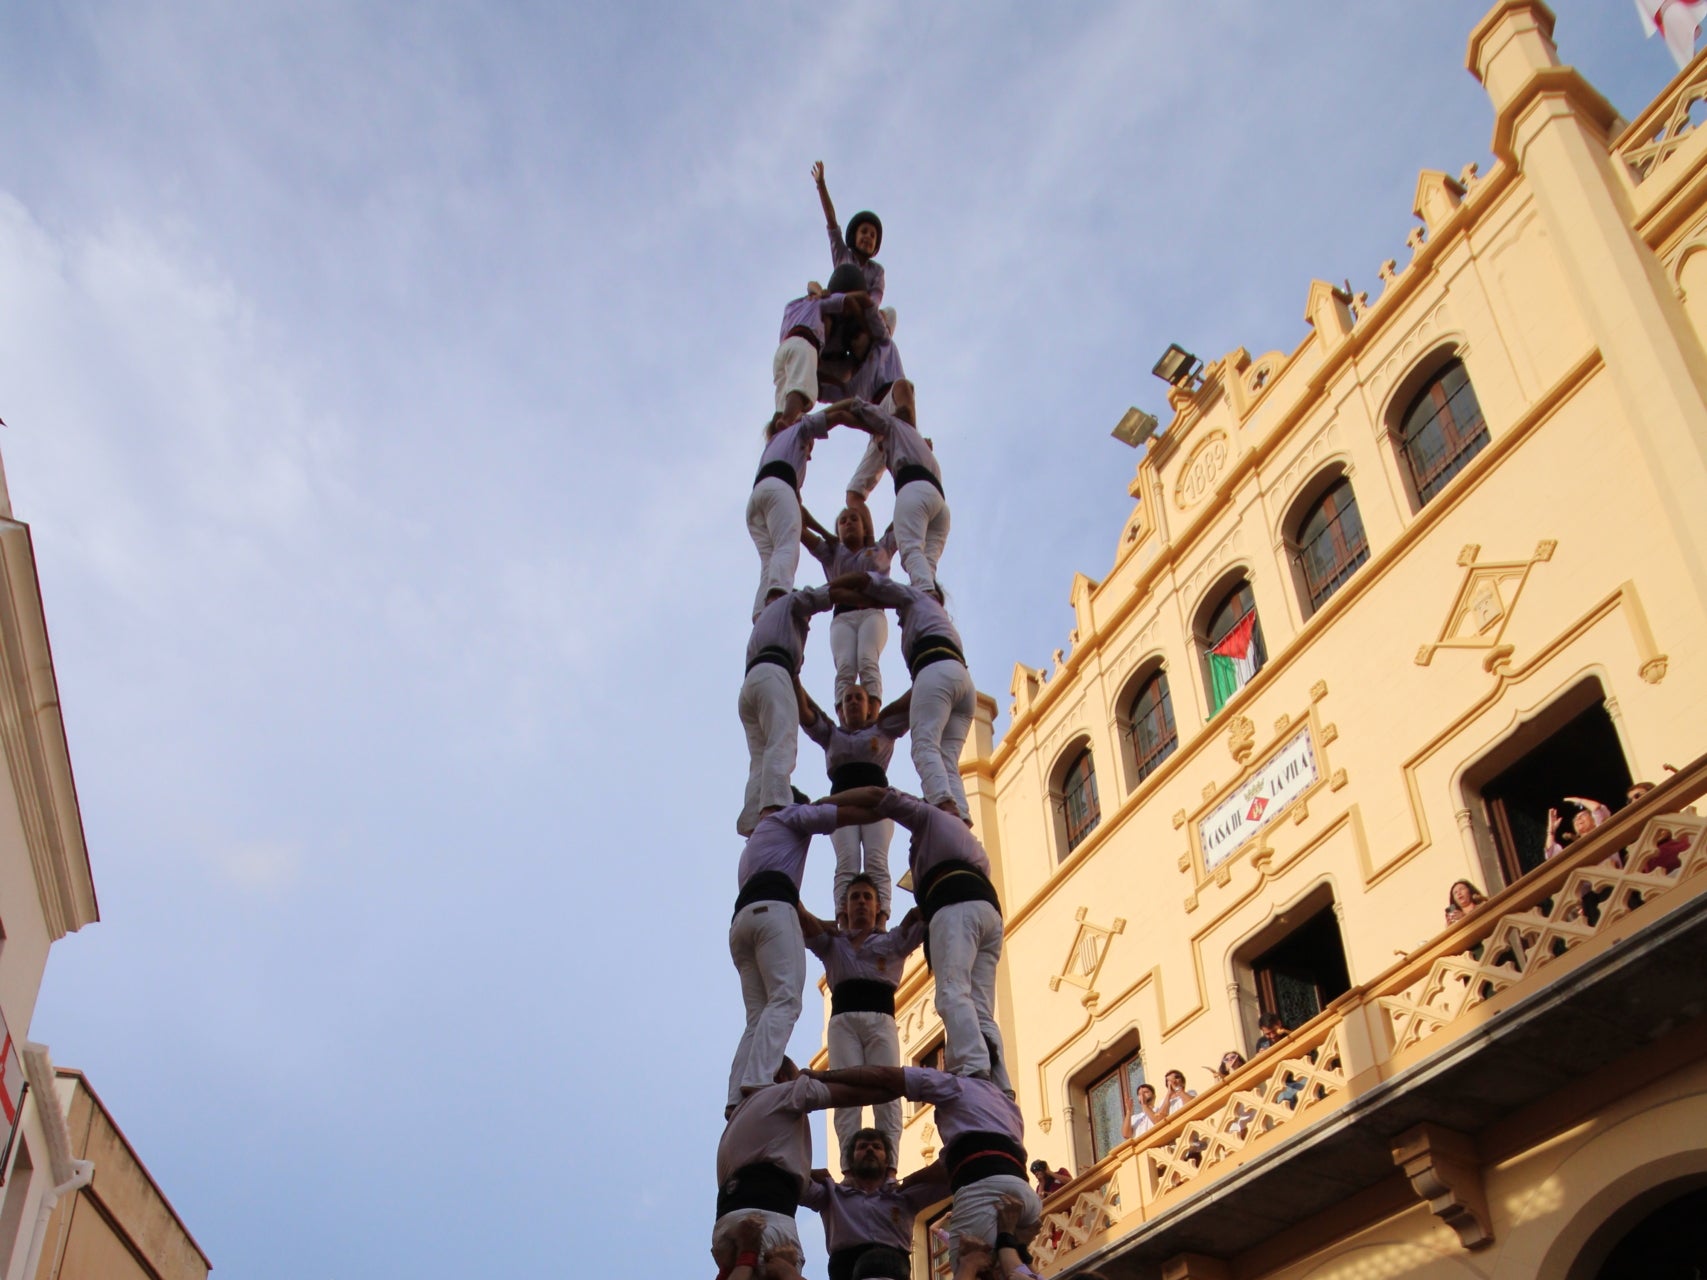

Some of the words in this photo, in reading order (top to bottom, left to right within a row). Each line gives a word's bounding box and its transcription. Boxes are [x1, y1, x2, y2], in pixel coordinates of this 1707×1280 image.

[1185, 443, 1225, 499] 1889
[1208, 820, 1231, 849] CASA
[1231, 809, 1242, 831] DE
[1271, 775, 1283, 797] LA
[1284, 752, 1308, 783] VILA
